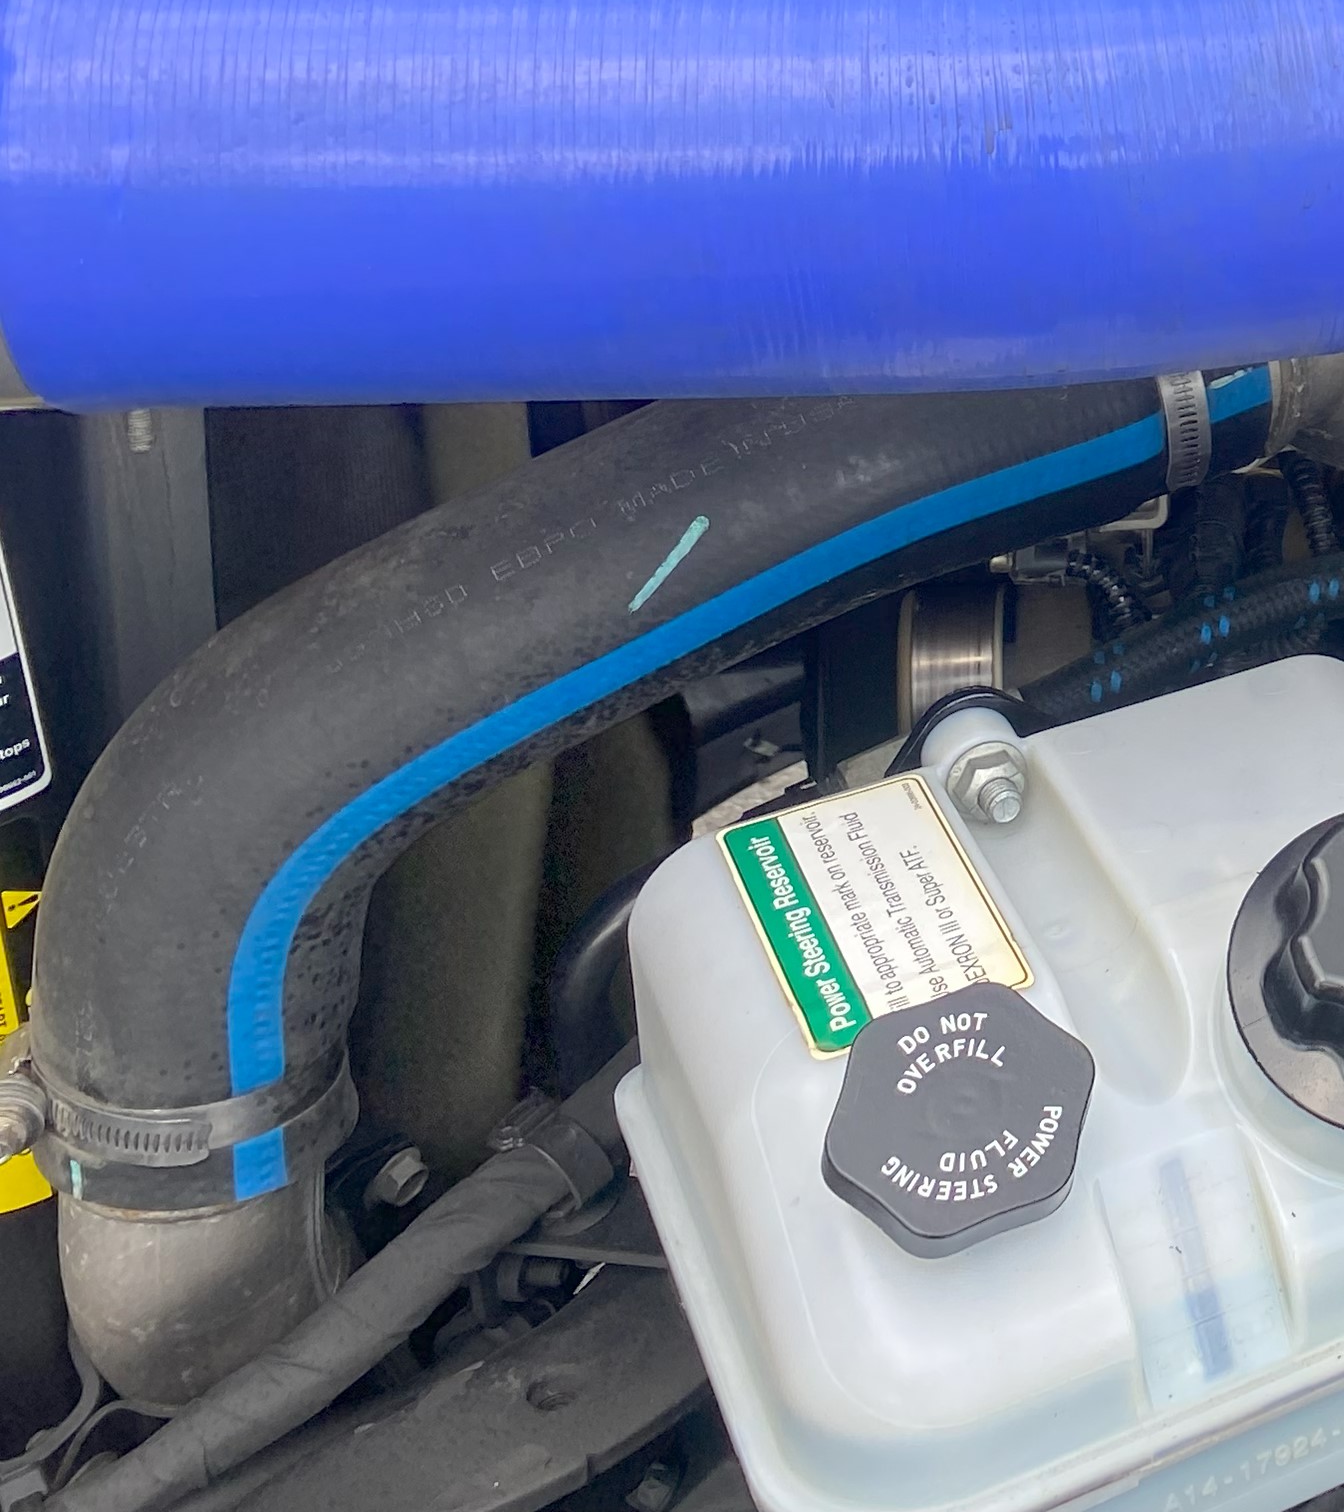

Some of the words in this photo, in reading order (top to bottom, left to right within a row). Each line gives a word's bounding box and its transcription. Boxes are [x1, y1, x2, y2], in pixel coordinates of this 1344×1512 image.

[800, 812, 836, 864] reservoir.
[839, 812, 865, 842] Fluid
[747, 836, 799, 910] Reservoir
[830, 864, 846, 881] on
[858, 840, 908, 918] Transmission
[899, 844, 927, 872] ATF.
[834, 880, 860, 911] mark
[916, 873, 947, 908] Super
[935, 906, 954, 920] or
[785, 906, 831, 979] Steering
[850, 910, 897, 984] appropriate
[897, 916, 938, 976] Automatic
[815, 977, 857, 1032] Power
[886, 980, 904, 1003] to
[887, 993, 911, 1010] ill
[897, 1025, 932, 1056] DO
[939, 1012, 989, 1036] NOT
[895, 1037, 1008, 1096] OVERFILL
[938, 1130, 1020, 1174] FLUID
[1007, 1104, 1064, 1180] POWER
[880, 1154, 999, 1202] STEERING
